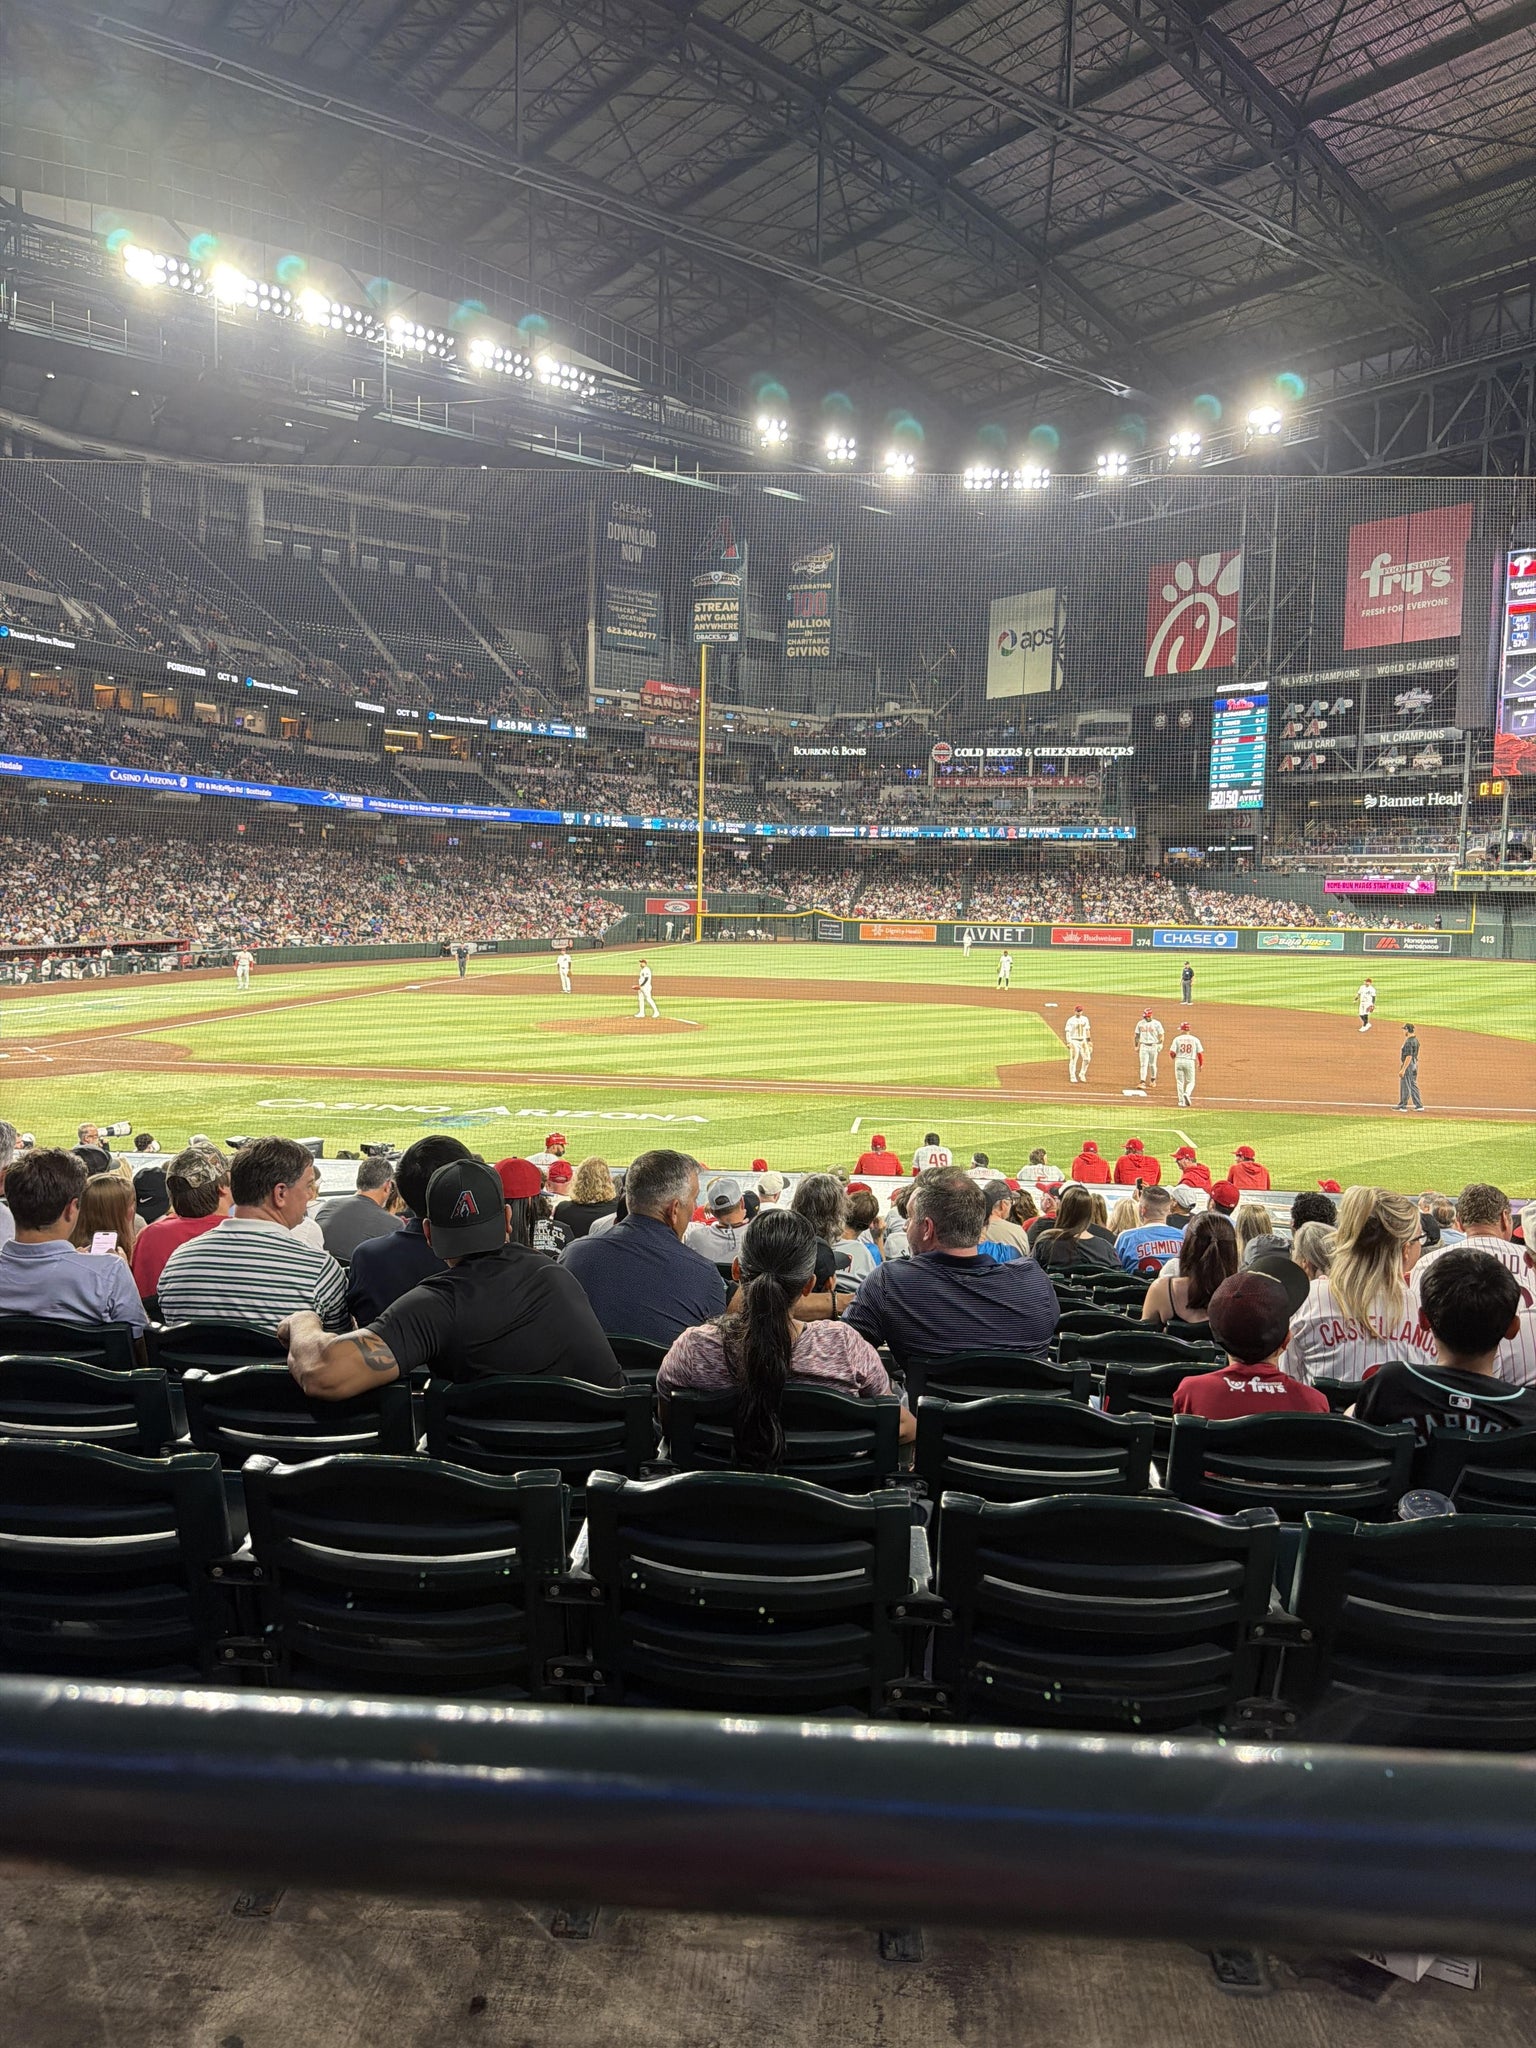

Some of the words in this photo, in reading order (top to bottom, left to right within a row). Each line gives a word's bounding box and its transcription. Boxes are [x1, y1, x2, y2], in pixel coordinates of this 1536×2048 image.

[607, 521, 657, 548] DOWNLOAD
[621, 543, 643, 564] NOW
[1360, 552, 1452, 598] fry's
[788, 582, 832, 591] CELEBRATING
[694, 602, 739, 612] STREAM
[1361, 605, 1386, 617] FRESH
[1387, 603, 1404, 615] FOR
[1406, 597, 1450, 612] EVERYONE
[694, 613, 712, 622] ANY
[714, 613, 739, 621] GAME
[694, 622, 739, 631] ANYWHERE
[787, 619, 831, 629] MILLION
[606, 625, 657, 640] 623.304.0777
[804, 629, 813, 637] IN
[787, 638, 830, 646] CHARITABLE
[1020, 626, 1055, 653] aps
[786, 646, 830, 657] GIVING
[1376, 663, 1404, 675] WORLD
[1406, 657, 1456, 672] CHAMPIONS
[217, 671, 231, 682] OCT
[1280, 677, 1290, 686] NL
[1292, 674, 1313, 685] WEST
[1314, 668, 1360, 683] CHAMPIONS
[642, 694, 702, 712] SANDLO
[396, 708, 411, 718] OCT
[517, 720, 533, 733] PM
[1380, 734, 1391, 743] NL
[1392, 729, 1445, 742] CHAMPIONS
[1293, 740, 1313, 750] WILD
[1314, 739, 1336, 749] CARD
[793, 746, 831, 756] BOURBON
[831, 746, 840, 756] &
[841, 746, 867, 756] BONES
[954, 747, 983, 758] COLD
[986, 747, 1023, 757] BEERS
[1025, 748, 1033, 758] &
[1033, 746, 1134, 757] CHEESEBURGERS
[110, 769, 141, 783] CASINO
[142, 772, 178, 787] ARIZONA
[980, 777, 1016, 788] Neighborhood
[1017, 777, 1038, 788] Burger
[1038, 777, 1053, 786] Joint
[1378, 794, 1426, 808] Banner
[1427, 790, 1465, 806] Healt
[963, 927, 1025, 941] AVNET
[1083, 934, 1123, 943] Budweiser
[1163, 933, 1212, 944] CHASE
[1480, 935, 1495, 944] 413
[1136, 938, 1151, 947] 374
[1403, 936, 1438, 945] Honeywell
[1403, 943, 1440, 951] Aerospace
[1180, 1043, 1193, 1054] 38
[255, 1098, 453, 1114] CASINO
[471, 1105, 711, 1123] ARIZONA
[928, 1153, 948, 1167] 49
[1247, 1376, 1288, 1395] fry's
